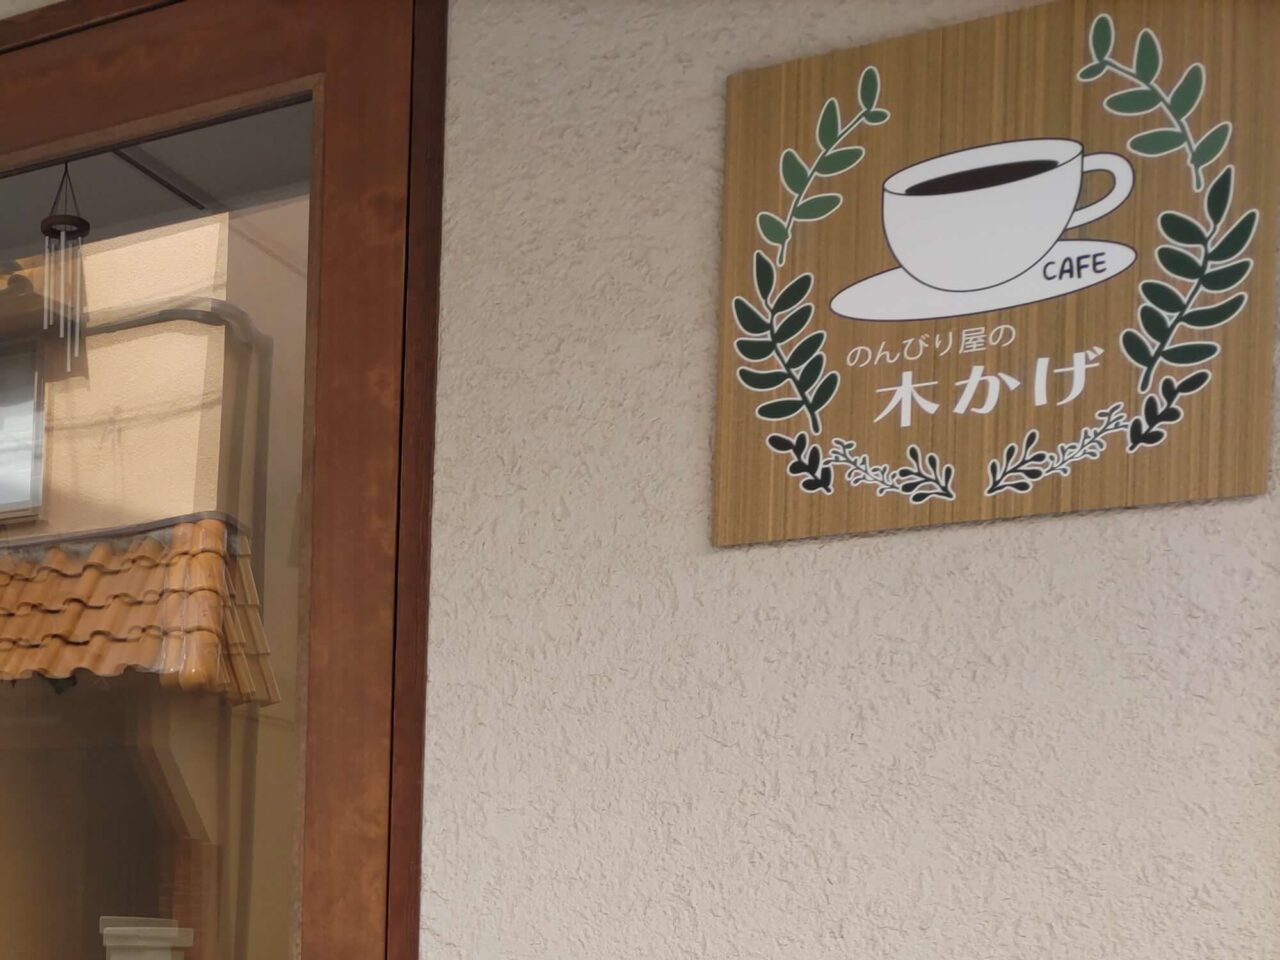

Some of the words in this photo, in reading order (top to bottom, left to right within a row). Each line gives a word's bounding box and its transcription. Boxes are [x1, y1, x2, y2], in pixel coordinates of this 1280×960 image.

[1042, 252, 1107, 281] CAFE
[846, 324, 1016, 368] のんびり屋の
[873, 346, 1104, 428] 木かげ
